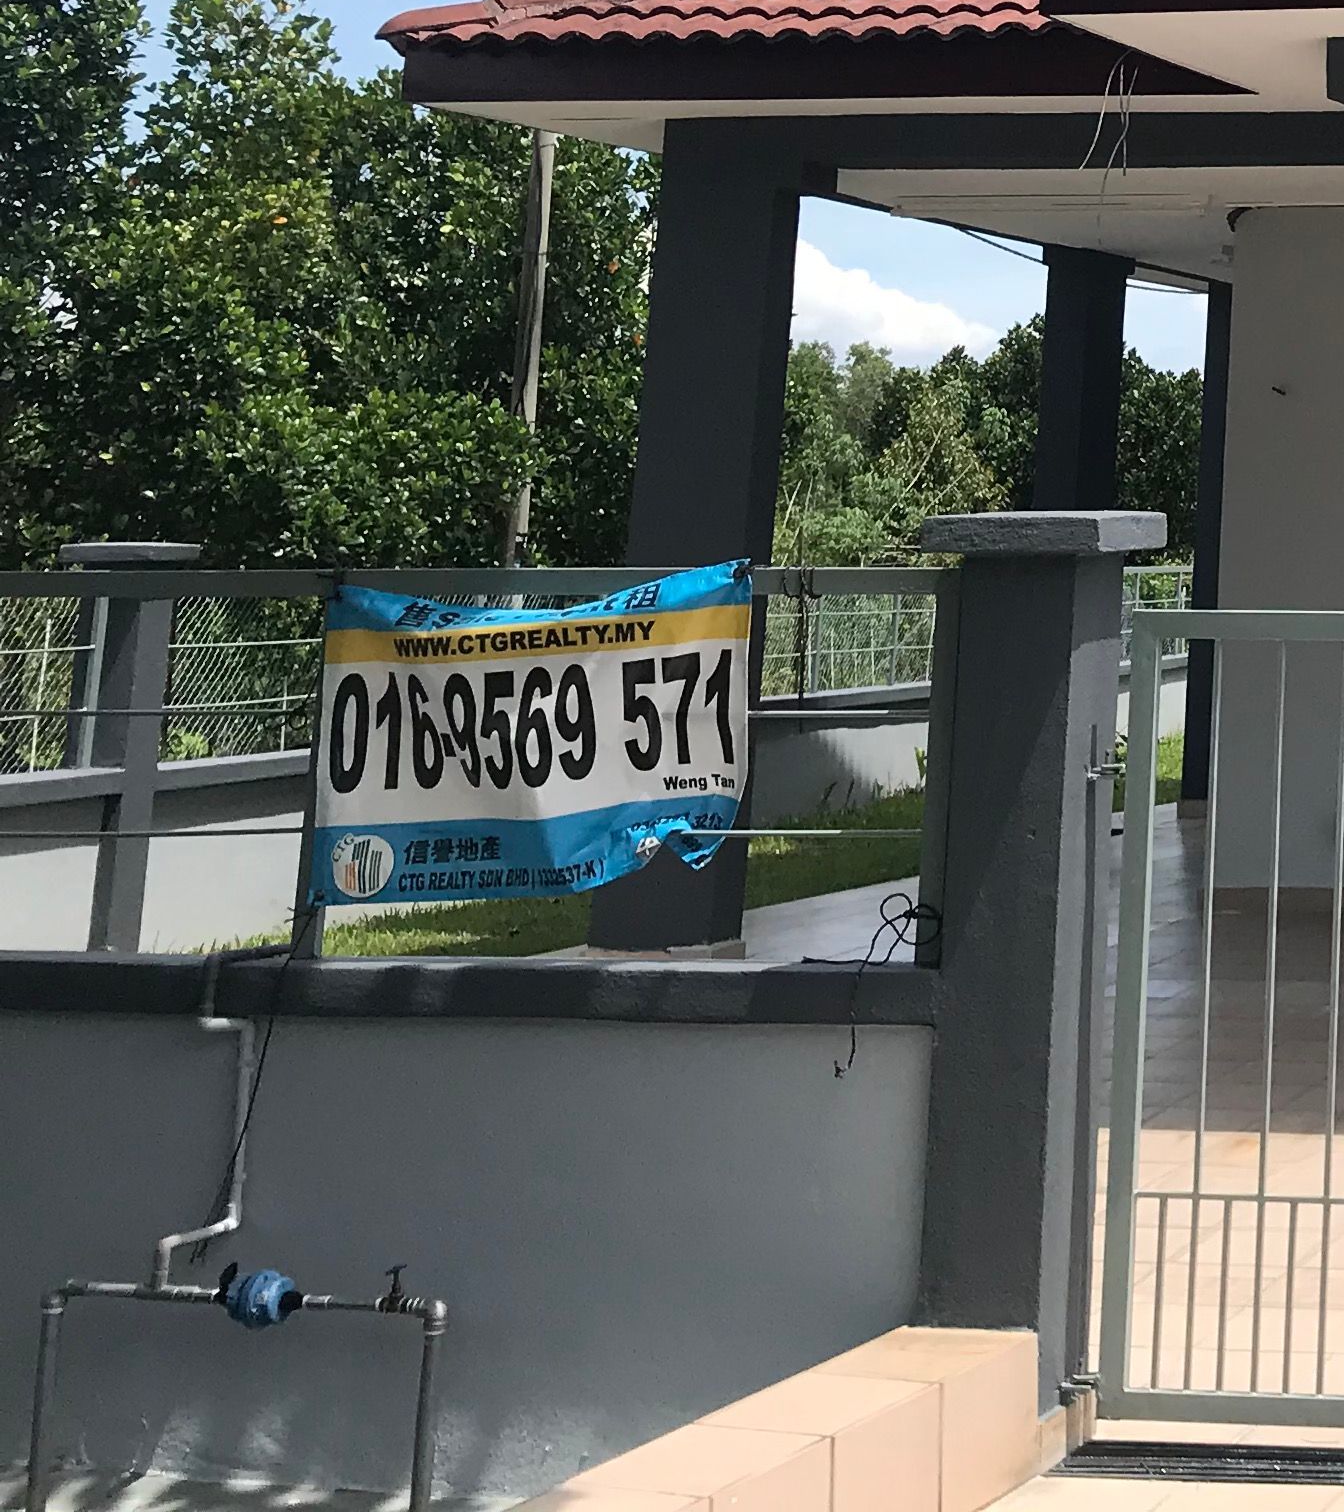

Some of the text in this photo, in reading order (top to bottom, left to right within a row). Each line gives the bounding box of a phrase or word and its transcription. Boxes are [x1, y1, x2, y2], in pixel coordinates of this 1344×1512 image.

[624, 582, 662, 610] 租
[393, 620, 656, 659] WWW.CTGREALTY.MY
[622, 649, 735, 771] 571
[662, 773, 736, 791] Weng Tan
[398, 870, 425, 892] CTG
[429, 869, 475, 892] REALTY
